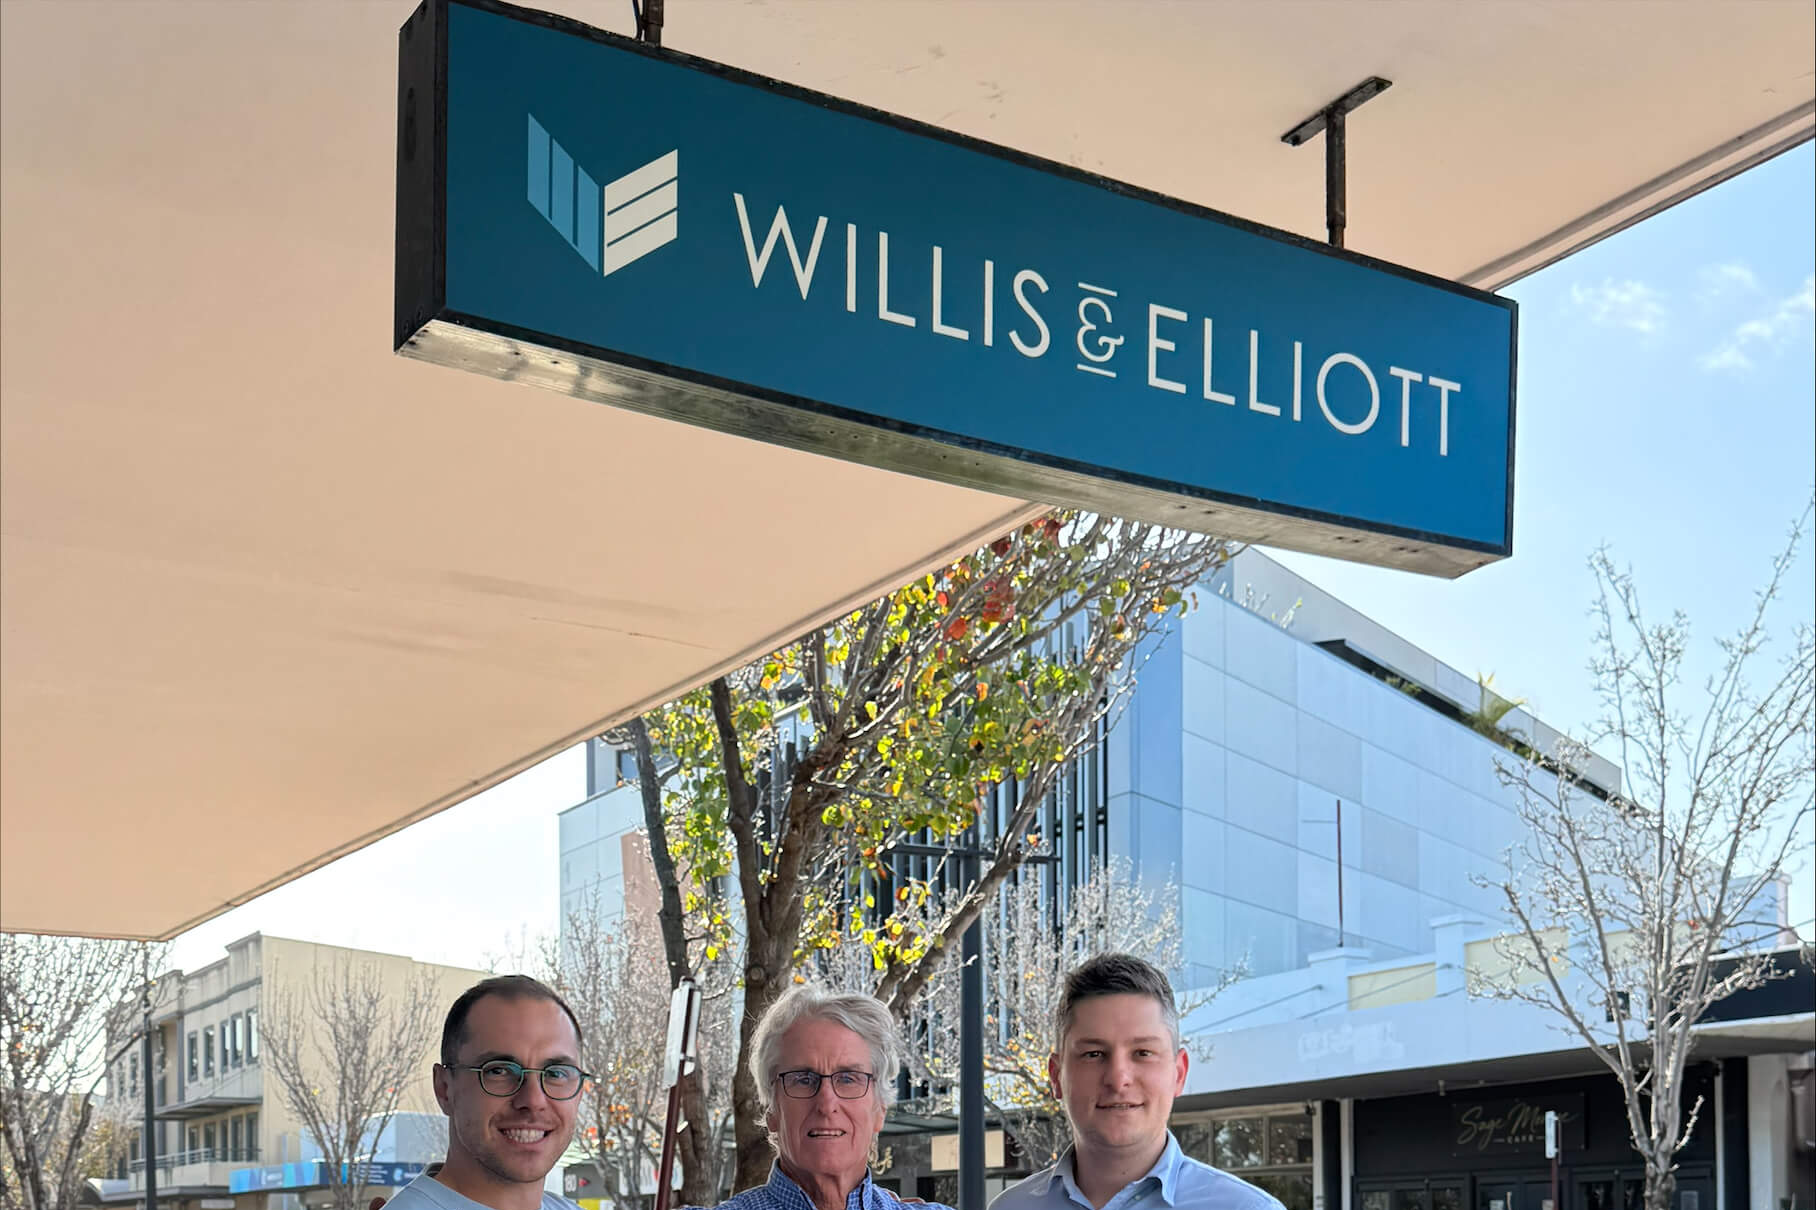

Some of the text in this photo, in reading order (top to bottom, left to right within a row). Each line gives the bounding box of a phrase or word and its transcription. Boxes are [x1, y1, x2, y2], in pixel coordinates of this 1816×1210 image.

[733, 193, 1462, 456] WILLIS & ELLIOTT
